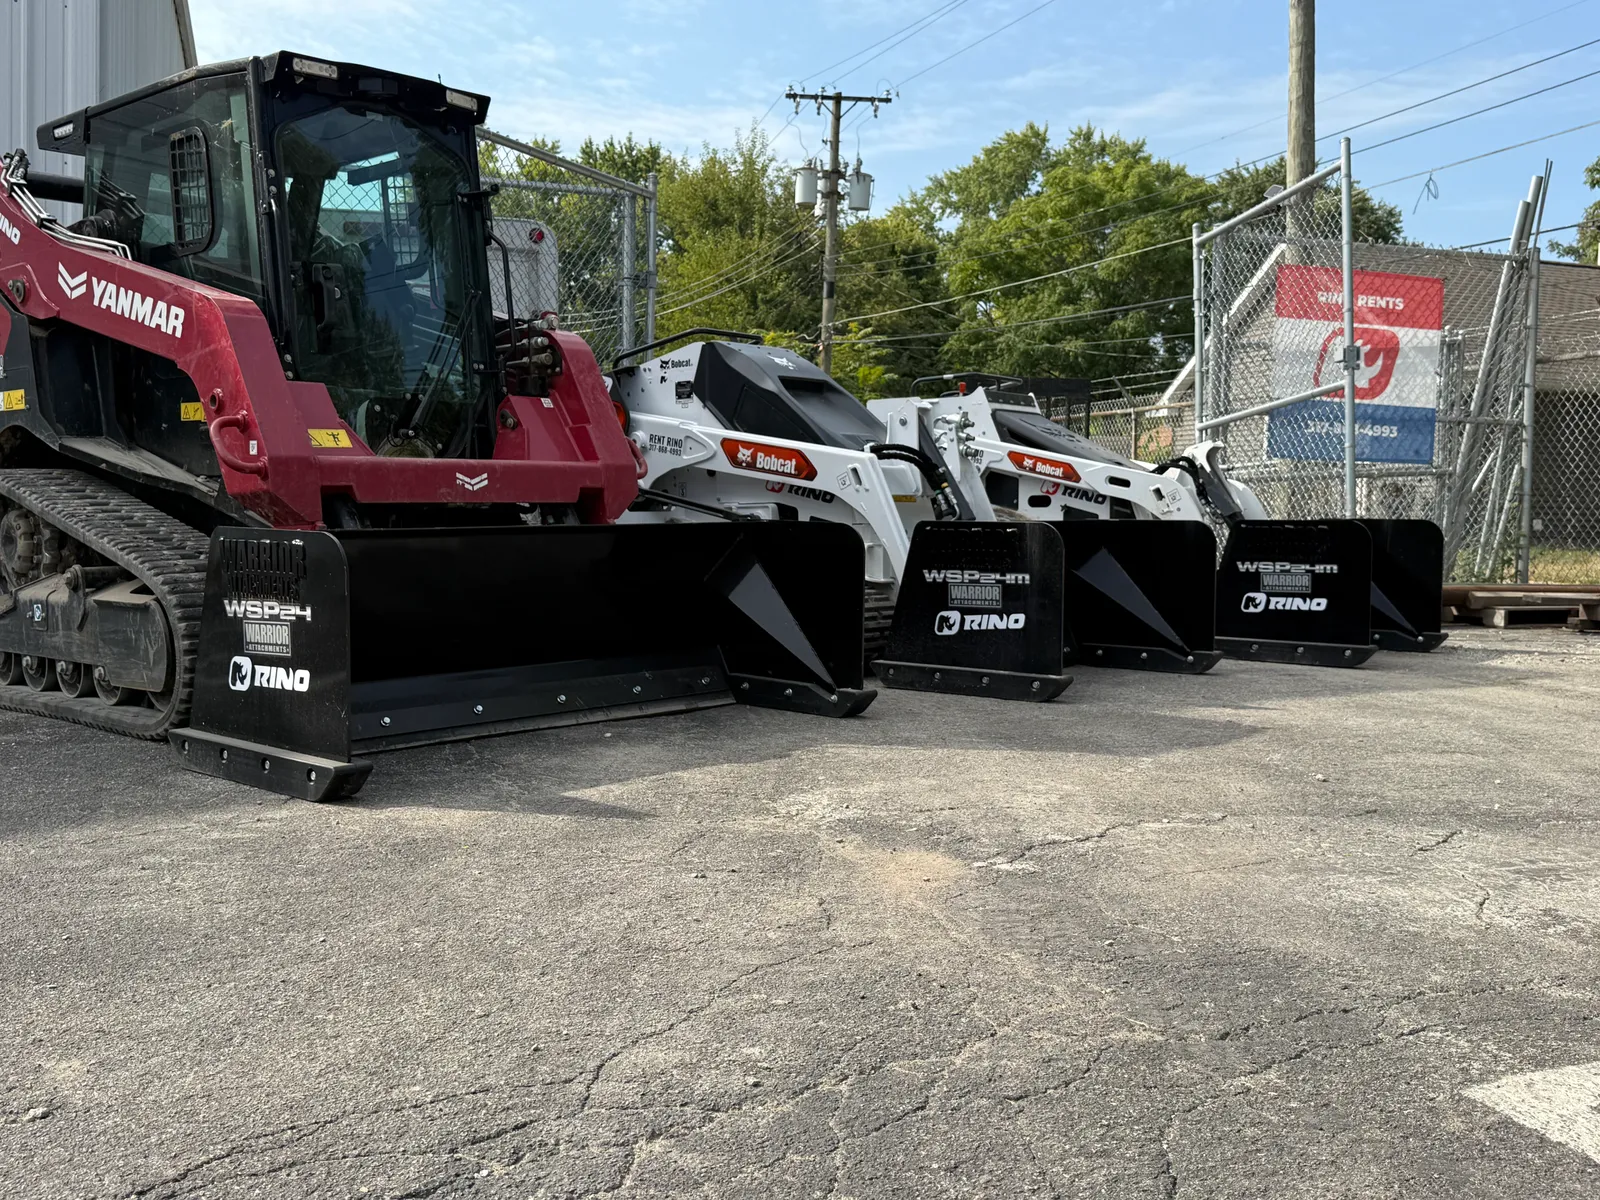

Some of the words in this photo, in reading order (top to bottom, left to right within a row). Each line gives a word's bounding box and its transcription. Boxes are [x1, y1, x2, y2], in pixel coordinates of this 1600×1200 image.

[0, 213, 21, 245] INO
[92, 276, 186, 338] YANMAR
[1317, 291, 1344, 306] RIN
[1357, 294, 1404, 310] RENTS
[671, 358, 691, 369] Bobcat
[649, 433, 665, 446] RENT
[667, 436, 683, 449] RINO
[649, 443, 682, 457] 317-868-4993
[756, 451, 797, 475] Bobcat
[1035, 461, 1063, 477] Bobcat
[787, 484, 835, 504] RINO
[1061, 485, 1107, 505] RINO
[1262, 574, 1309, 587] WARRIOR
[951, 586, 999, 600] WARRIOR
[223, 599, 312, 621] WSP24
[1268, 596, 1328, 611] RINO
[963, 613, 1026, 630] RINO
[245, 623, 289, 645] WARRIOR
[248, 644, 287, 653] ATTACHMENTS
[254, 664, 311, 692] RINO
